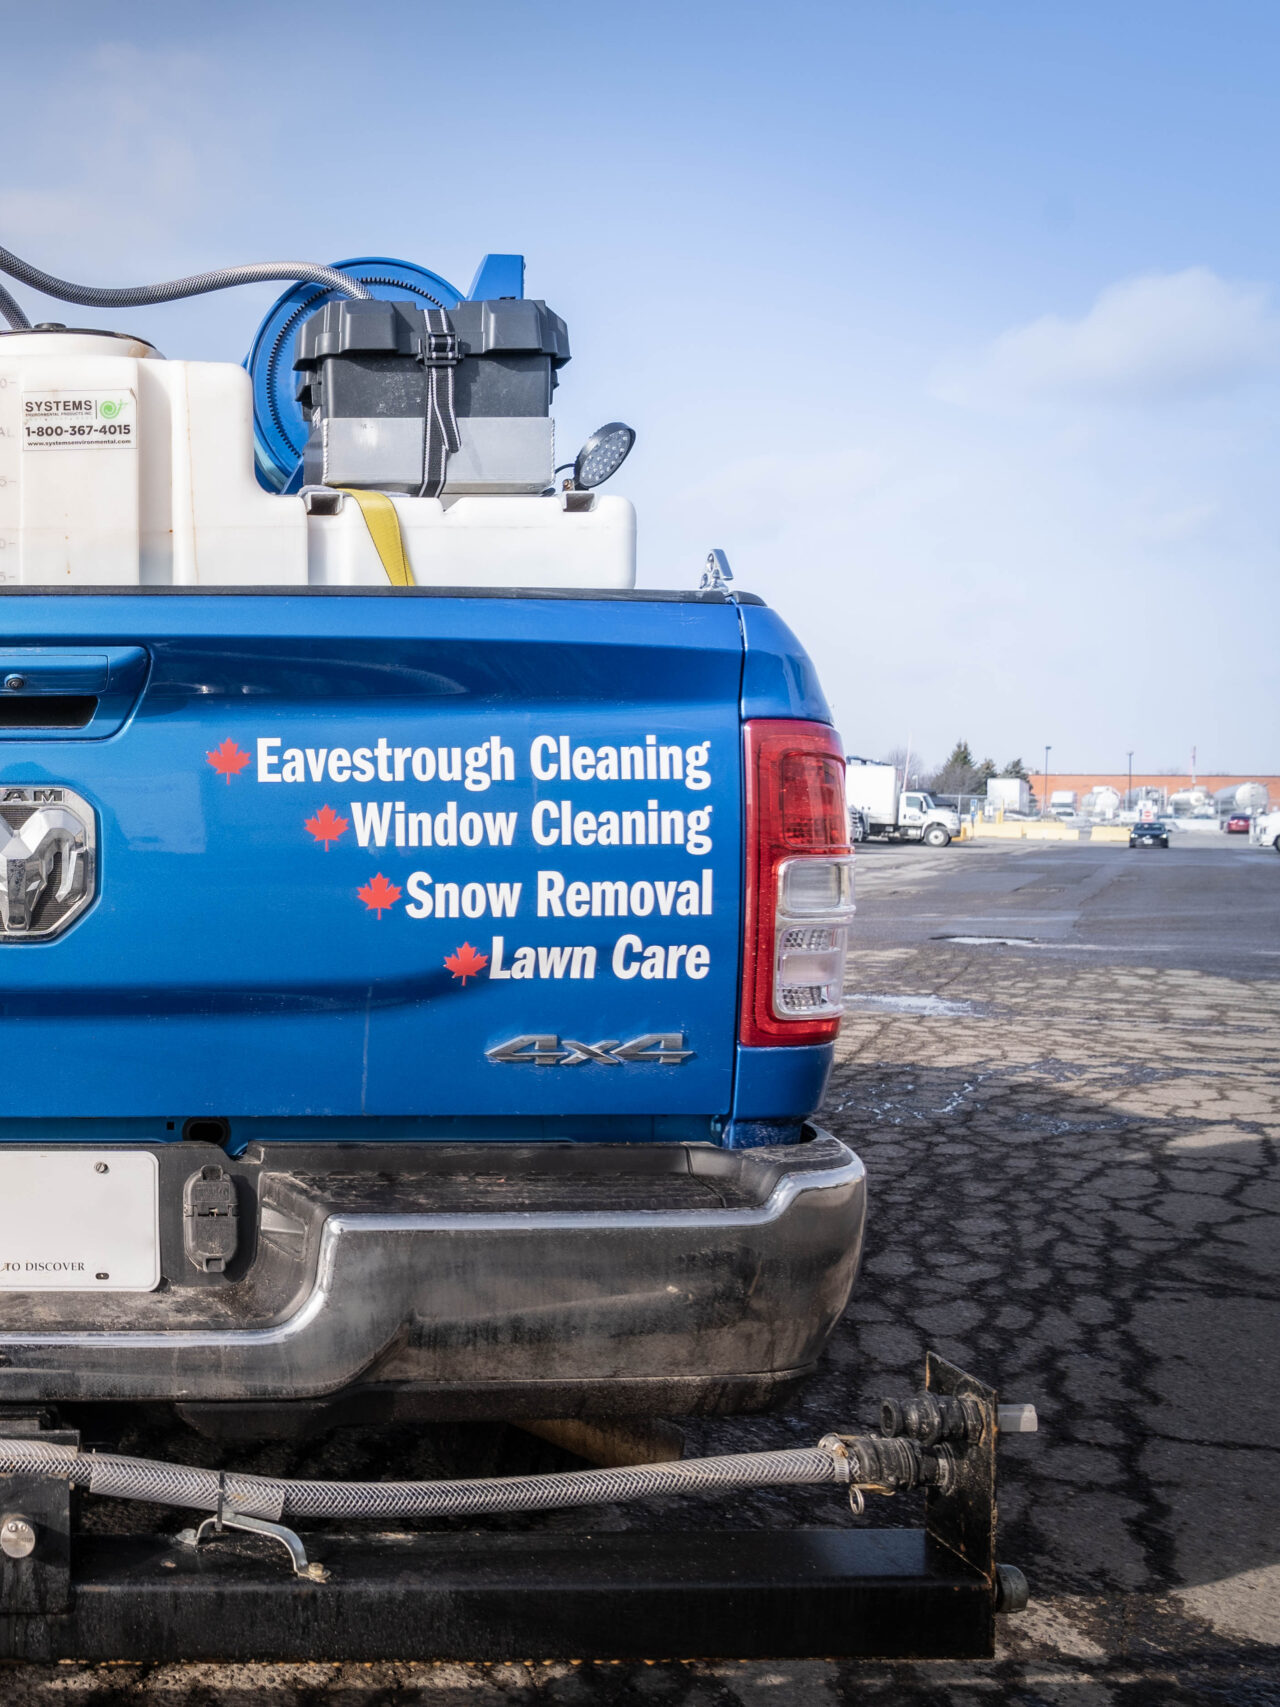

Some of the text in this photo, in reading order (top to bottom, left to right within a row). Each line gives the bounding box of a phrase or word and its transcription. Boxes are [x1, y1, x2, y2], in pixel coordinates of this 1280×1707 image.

[25, 400, 93, 412] SYSTEMS
[25, 424, 131, 437] 1-800-367-4015
[27, 439, 132, 447] www.systemsenvironmental.com
[256, 734, 712, 792] Eavestrough Cleaning
[350, 799, 714, 856] Window Cleaning
[405, 869, 714, 919] Snow Removal
[488, 934, 711, 981] Lawn Care
[4, 1262, 21, 1272] TO
[25, 1262, 86, 1271] DISCOVER
